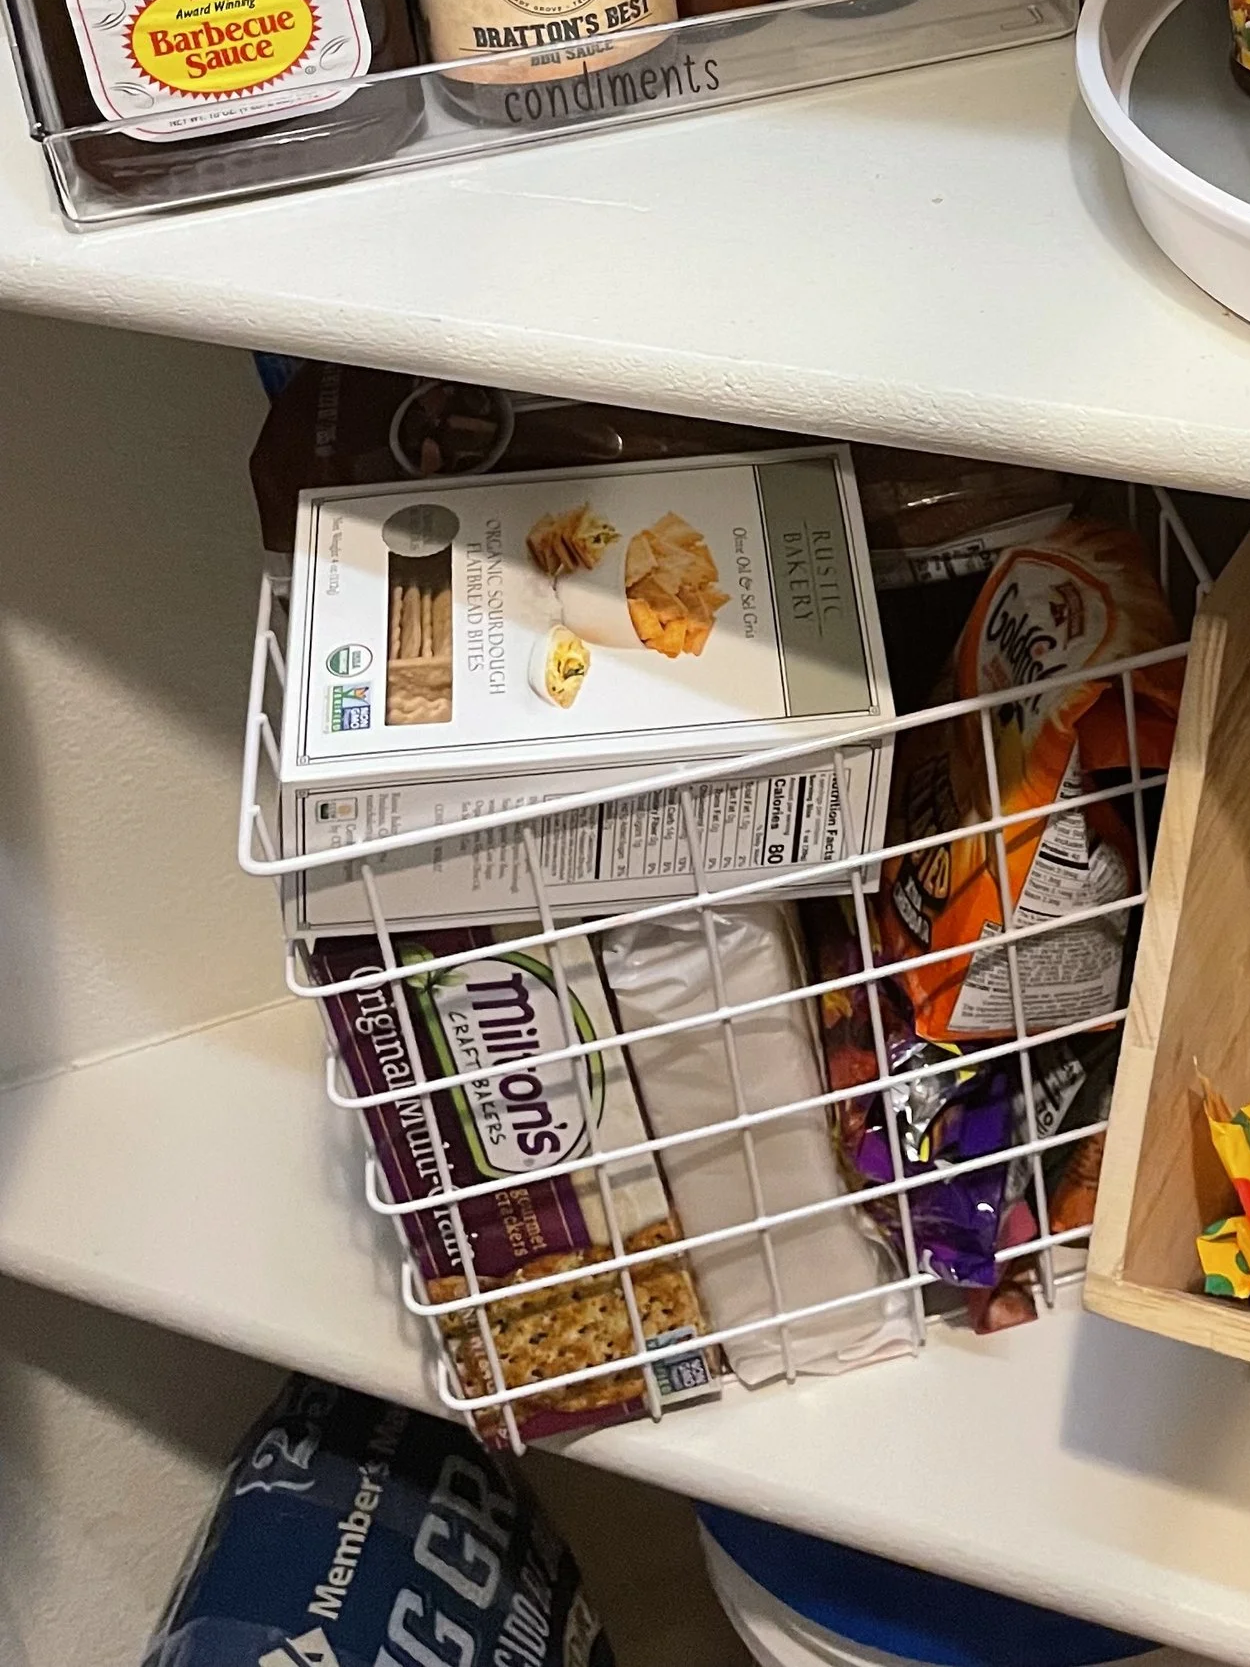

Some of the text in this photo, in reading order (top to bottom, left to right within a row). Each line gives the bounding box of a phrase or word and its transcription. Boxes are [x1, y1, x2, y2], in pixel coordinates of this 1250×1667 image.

[148, 10, 295, 57] Barbecue
[176, 2, 210, 21] Award
[472, 13, 600, 48] BRATTON'S
[185, 39, 275, 79] Sauce
[504, 54, 720, 124] condiments
[466, 542, 484, 672] FLATBREAD BITES
[486, 519, 506, 695] ORGANIC SOURDOUGH
[783, 532, 814, 620] BAKERY
[812, 530, 842, 622] RUSTIC
[768, 778, 786, 865] Calories 80
[823, 828, 838, 861] Facts
[472, 1077, 507, 1146] BAKERS
[495, 1192, 528, 1257] crackers
[509, 1188, 547, 1251] gourmet
[308, 1462, 390, 1620] Member's
